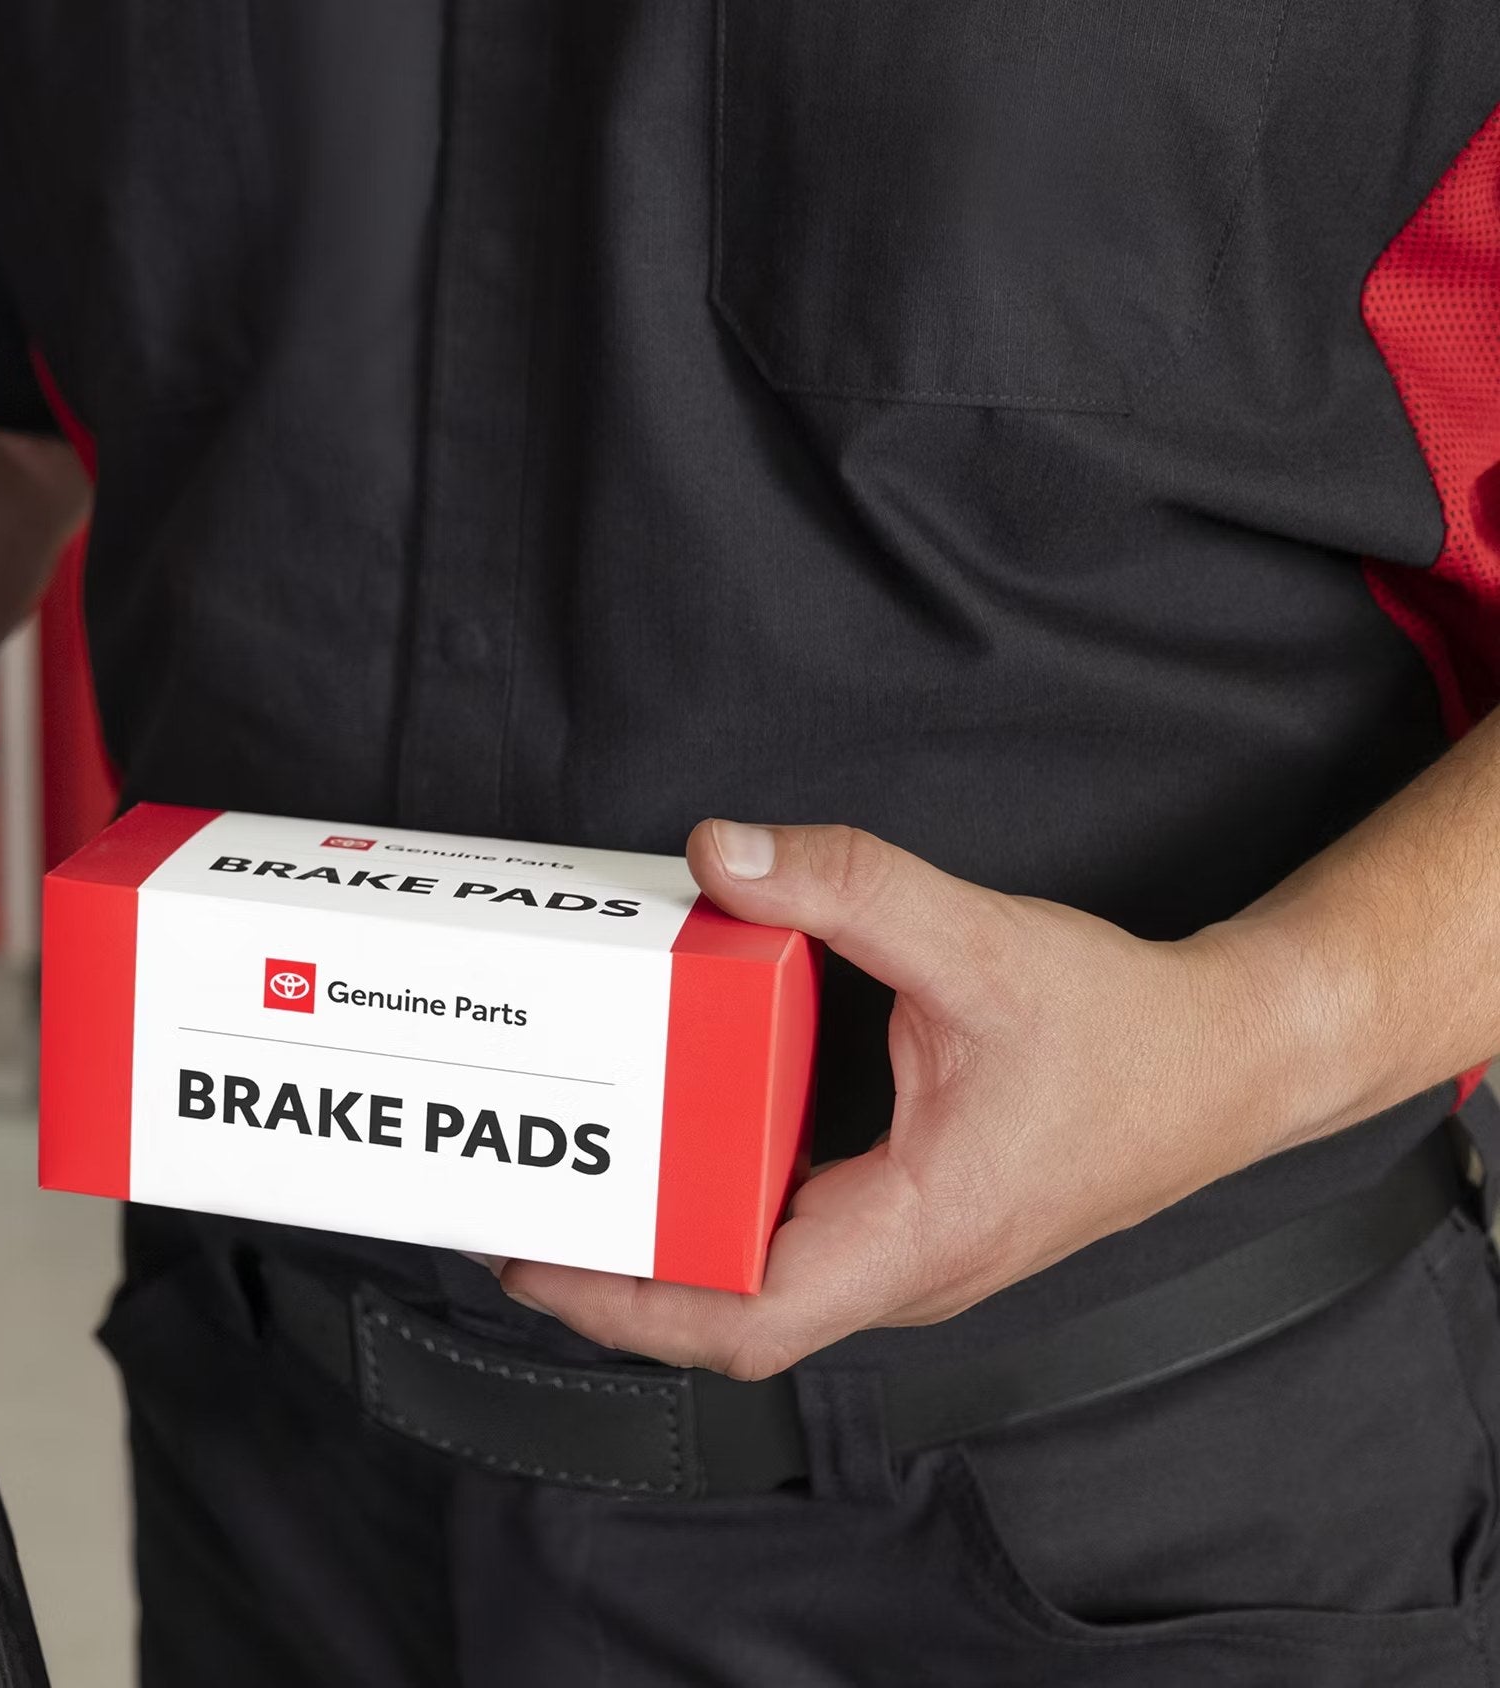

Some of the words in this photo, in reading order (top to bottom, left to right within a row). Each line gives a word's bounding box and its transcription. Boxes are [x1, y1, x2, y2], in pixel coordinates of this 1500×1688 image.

[384, 844, 498, 862] Genuine
[504, 856, 575, 870] Parts
[208, 855, 440, 895] BRAKE
[452, 881, 642, 918] PADS
[327, 980, 446, 1016] Genuine
[455, 996, 527, 1027] Parts
[178, 1068, 403, 1148] BRAKE
[424, 1101, 611, 1176] PADS
